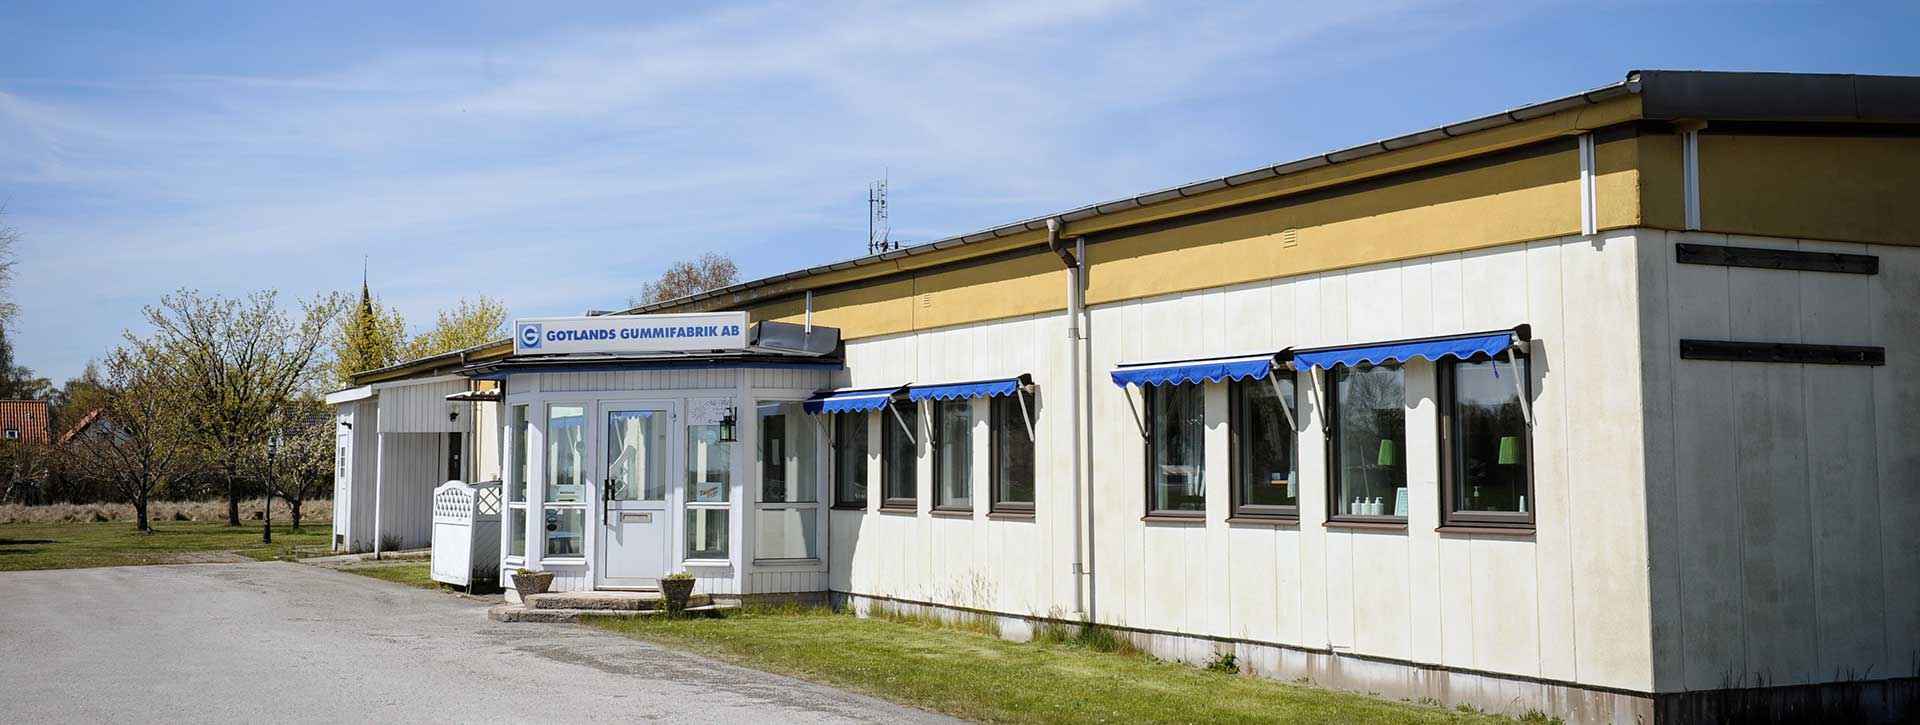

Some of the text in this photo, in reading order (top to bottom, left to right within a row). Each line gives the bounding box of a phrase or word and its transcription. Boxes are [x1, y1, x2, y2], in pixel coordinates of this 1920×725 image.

[546, 325, 740, 341] GOTLANDS GUMMIFABRIK AB
